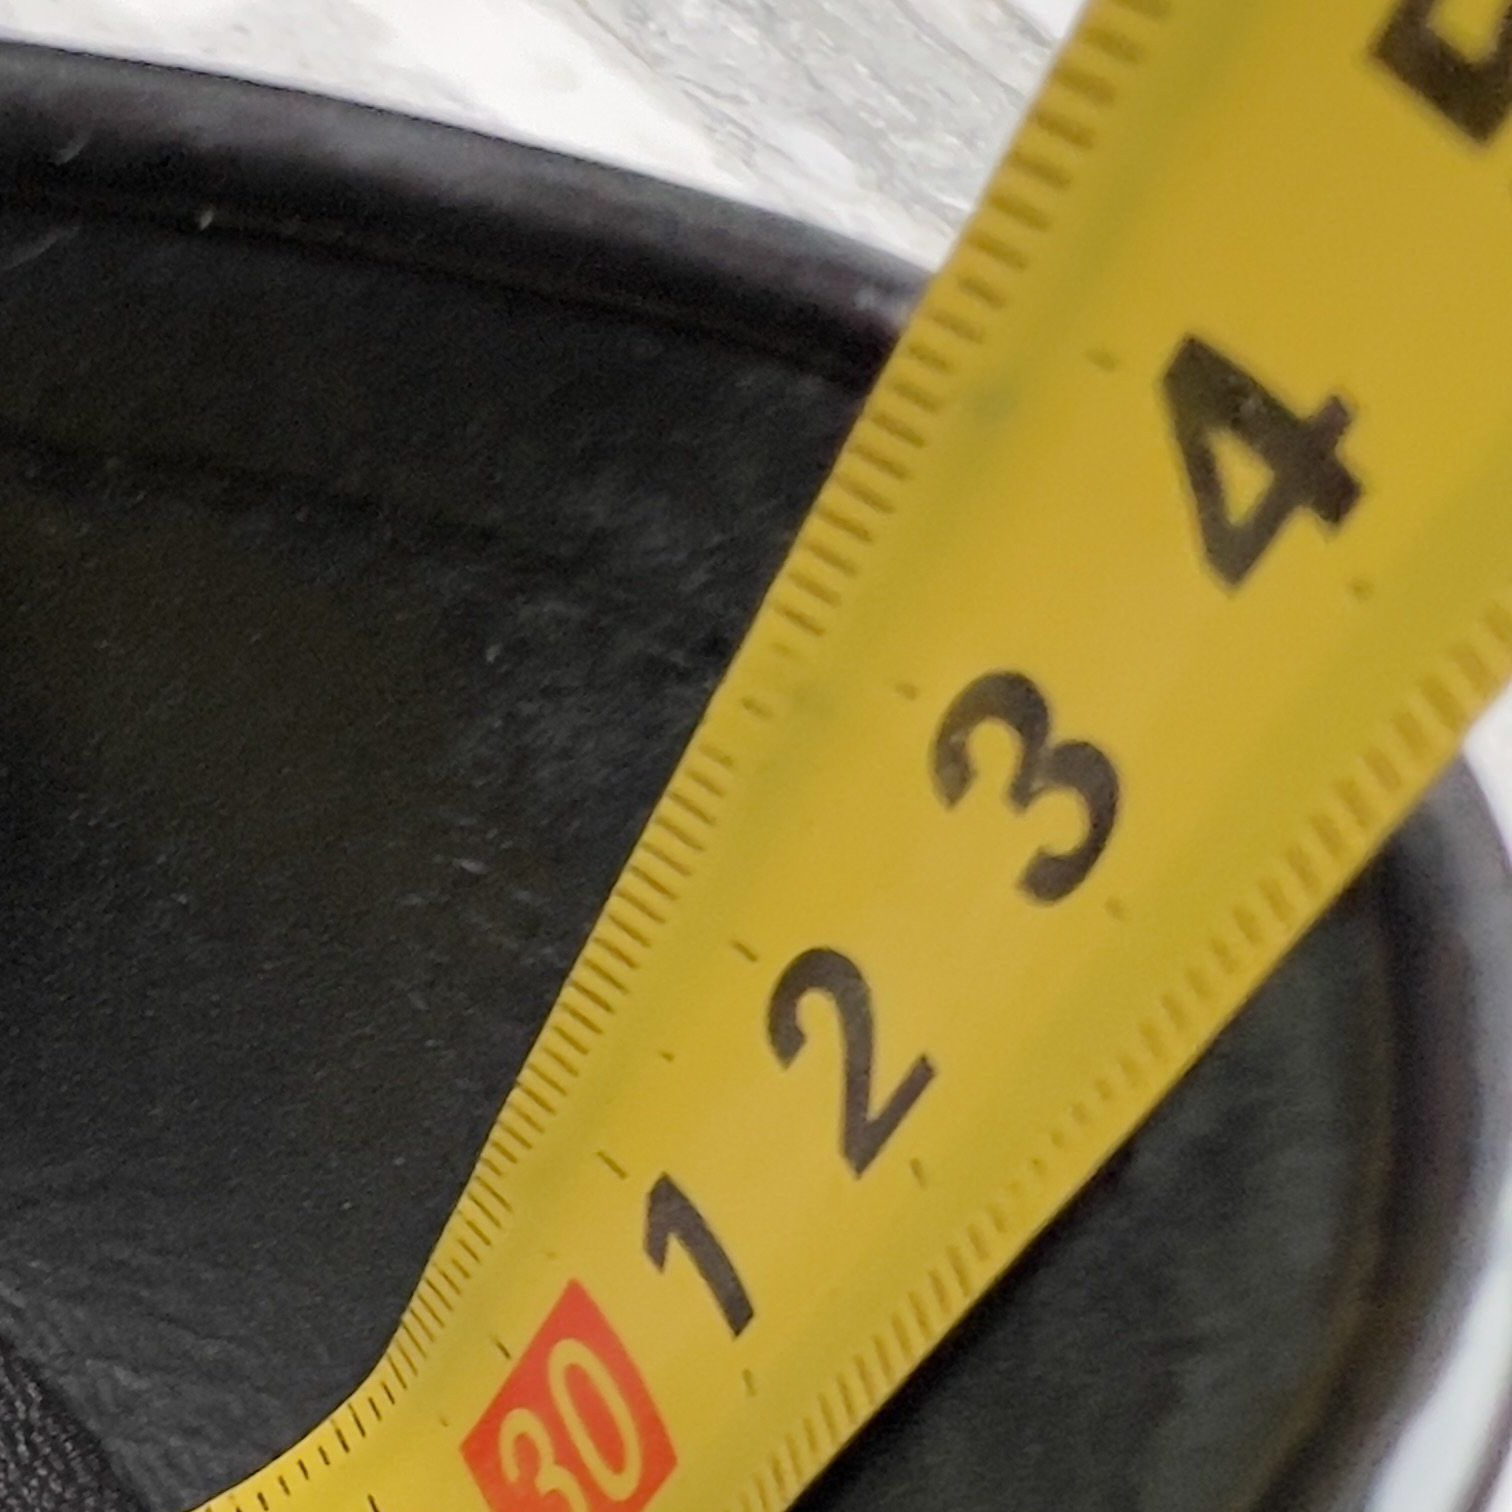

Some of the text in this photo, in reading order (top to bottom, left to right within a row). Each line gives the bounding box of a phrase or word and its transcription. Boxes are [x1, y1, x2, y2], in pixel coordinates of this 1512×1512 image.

[643, 1172, 755, 1339] 1
[766, 945, 938, 1180] 2
[928, 668, 1121, 906] 3
[1161, 332, 1363, 590] 4
